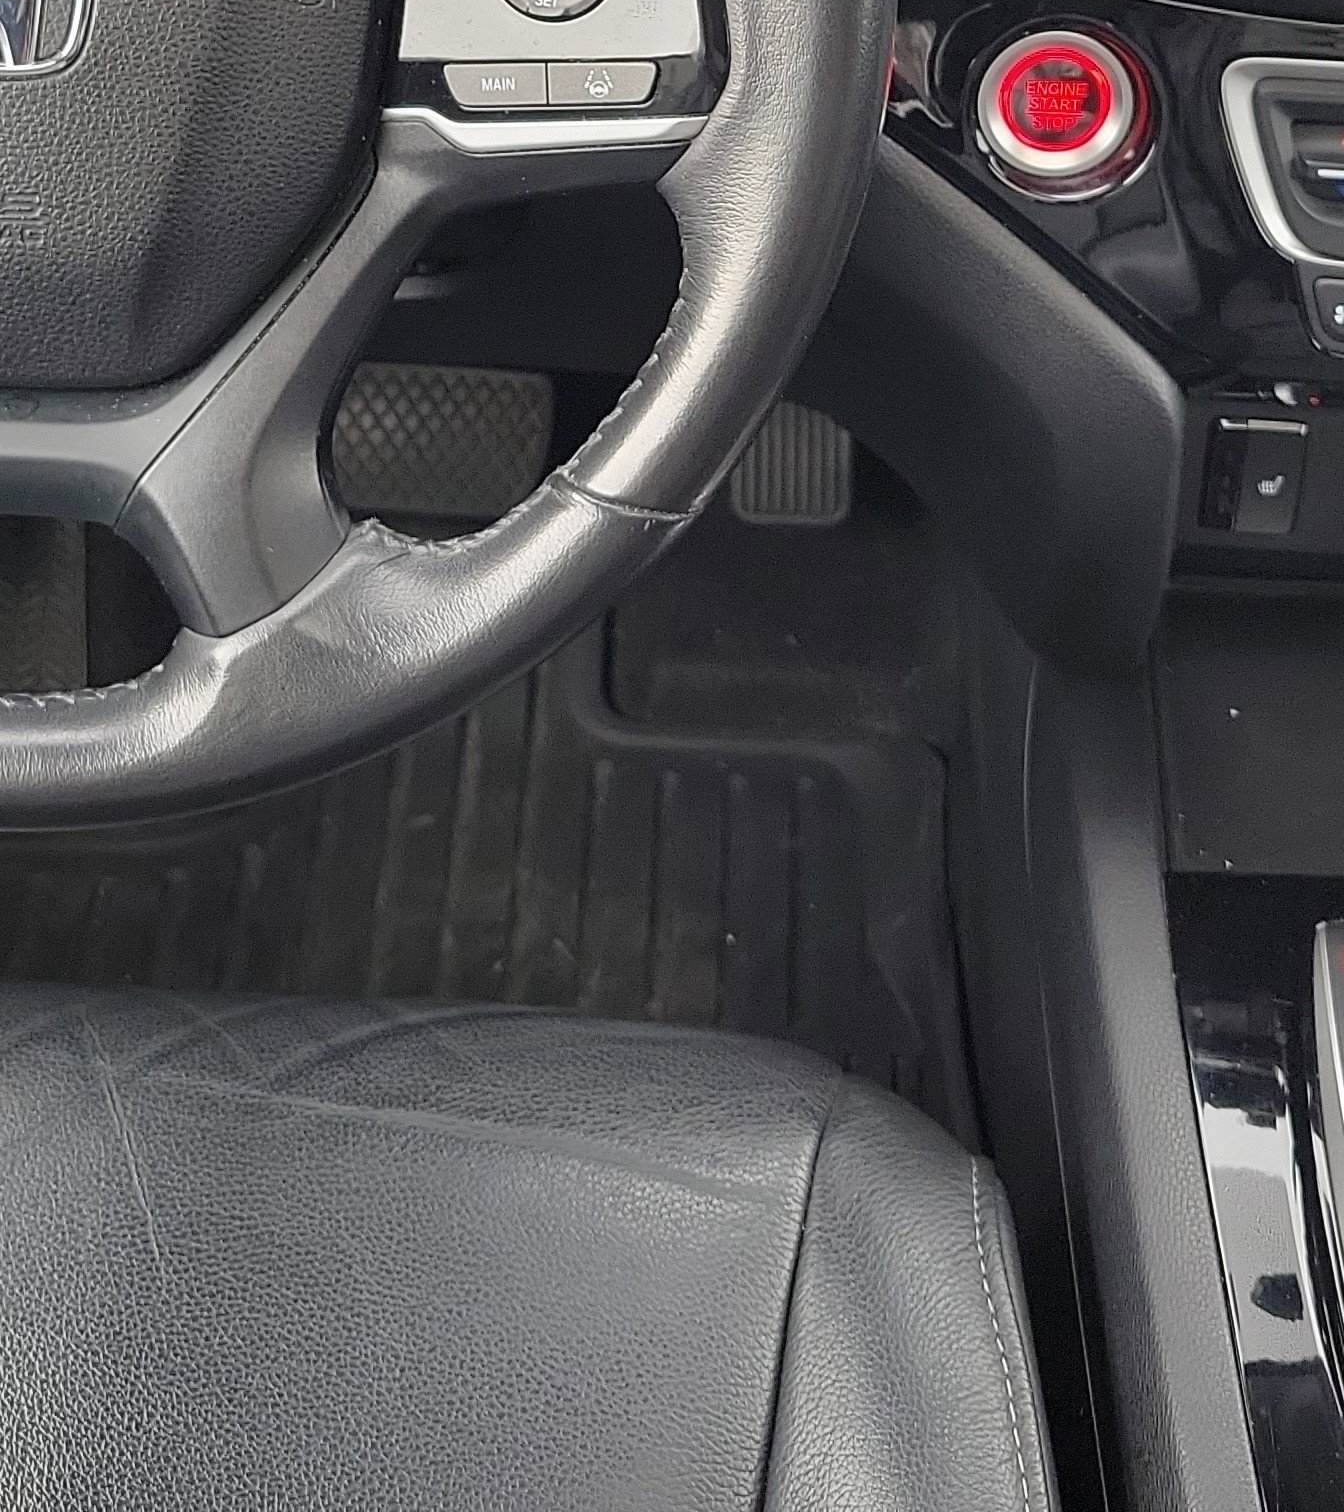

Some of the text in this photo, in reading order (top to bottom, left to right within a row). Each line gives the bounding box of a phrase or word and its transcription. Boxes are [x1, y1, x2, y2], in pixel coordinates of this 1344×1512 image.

[481, 77, 516, 92] MAIN
[1025, 80, 1089, 97] ENGINE
[1028, 97, 1083, 112] START
[1032, 115, 1077, 131] STOP
